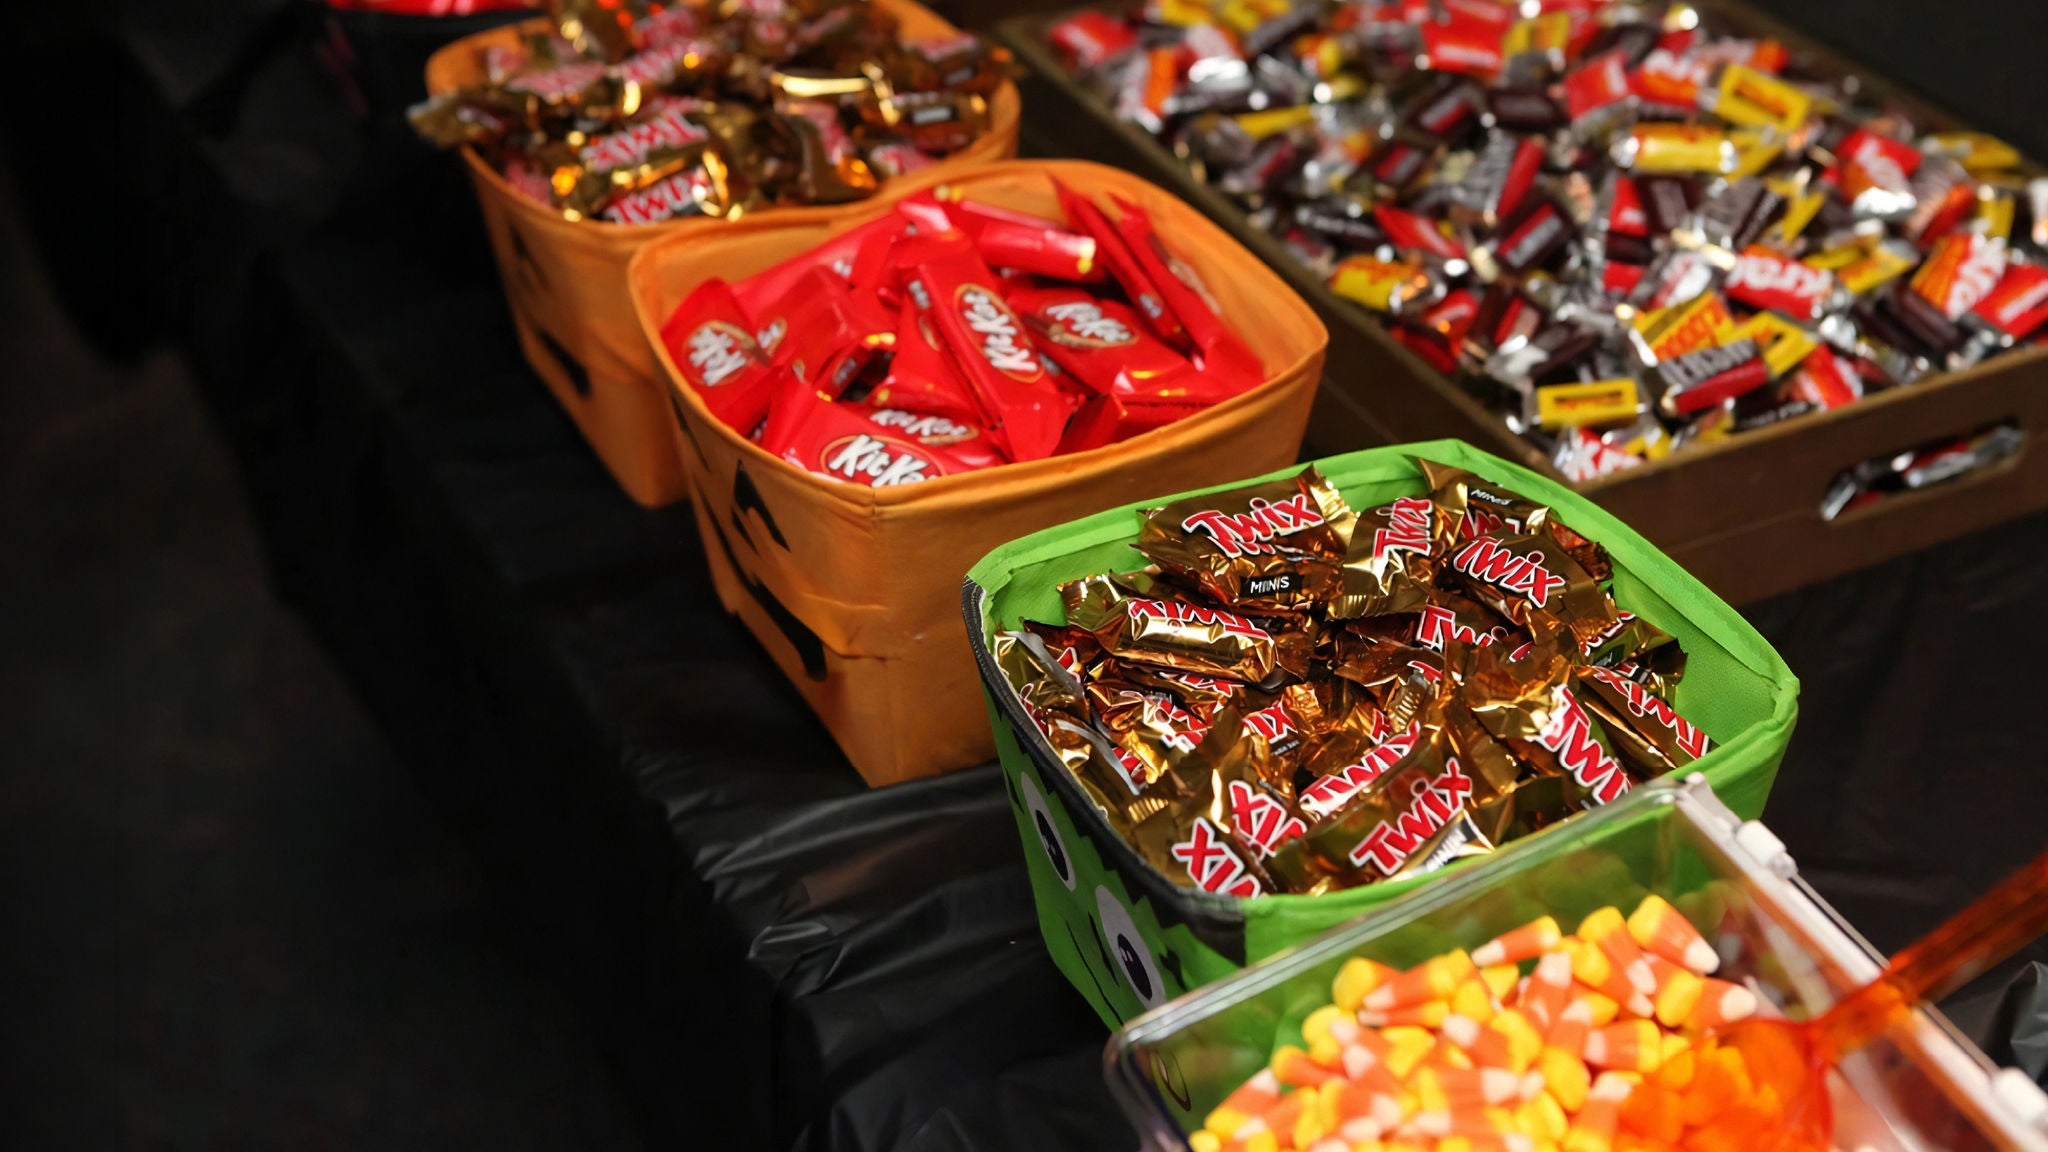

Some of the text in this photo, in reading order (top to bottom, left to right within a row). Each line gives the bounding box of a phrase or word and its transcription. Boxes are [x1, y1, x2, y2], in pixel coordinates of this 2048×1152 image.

[1453, 536, 1566, 608] Twix
[1536, 684, 1632, 805] Twi
[1350, 757, 1472, 875] Twix
